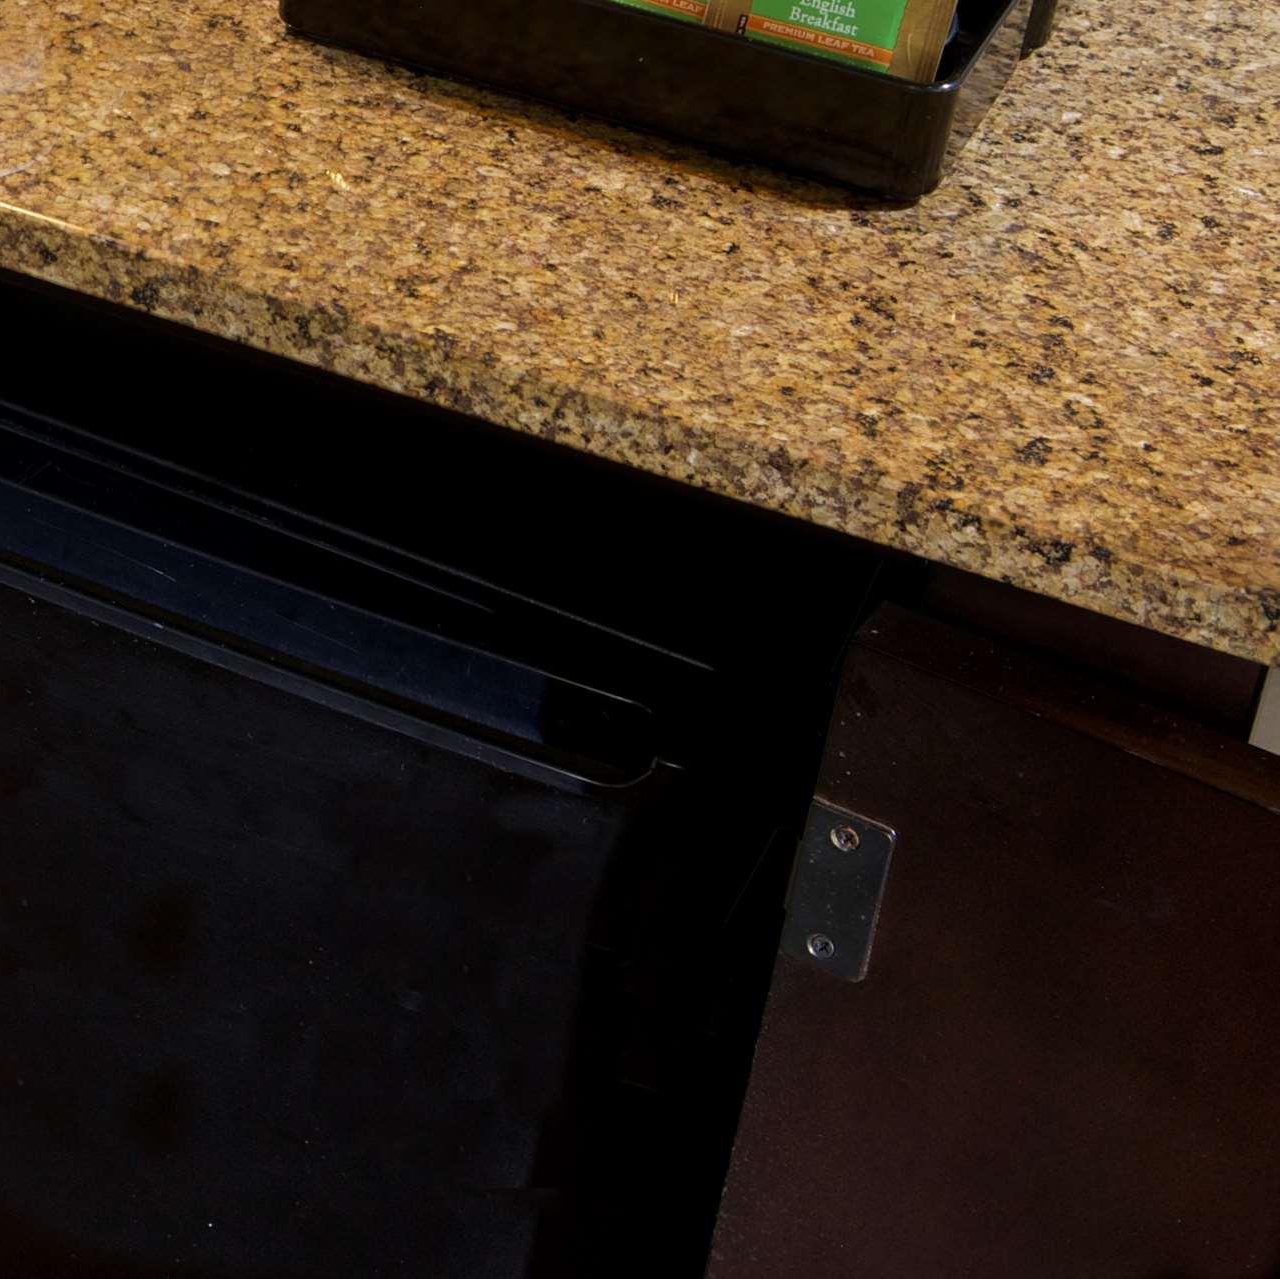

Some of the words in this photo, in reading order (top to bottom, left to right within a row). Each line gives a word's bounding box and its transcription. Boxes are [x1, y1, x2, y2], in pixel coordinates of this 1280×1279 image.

[789, 6, 859, 37] Breakfast
[763, 21, 816, 41] PREMIUM
[818, 33, 849, 50] LEAF
[852, 43, 875, 57] TEA
